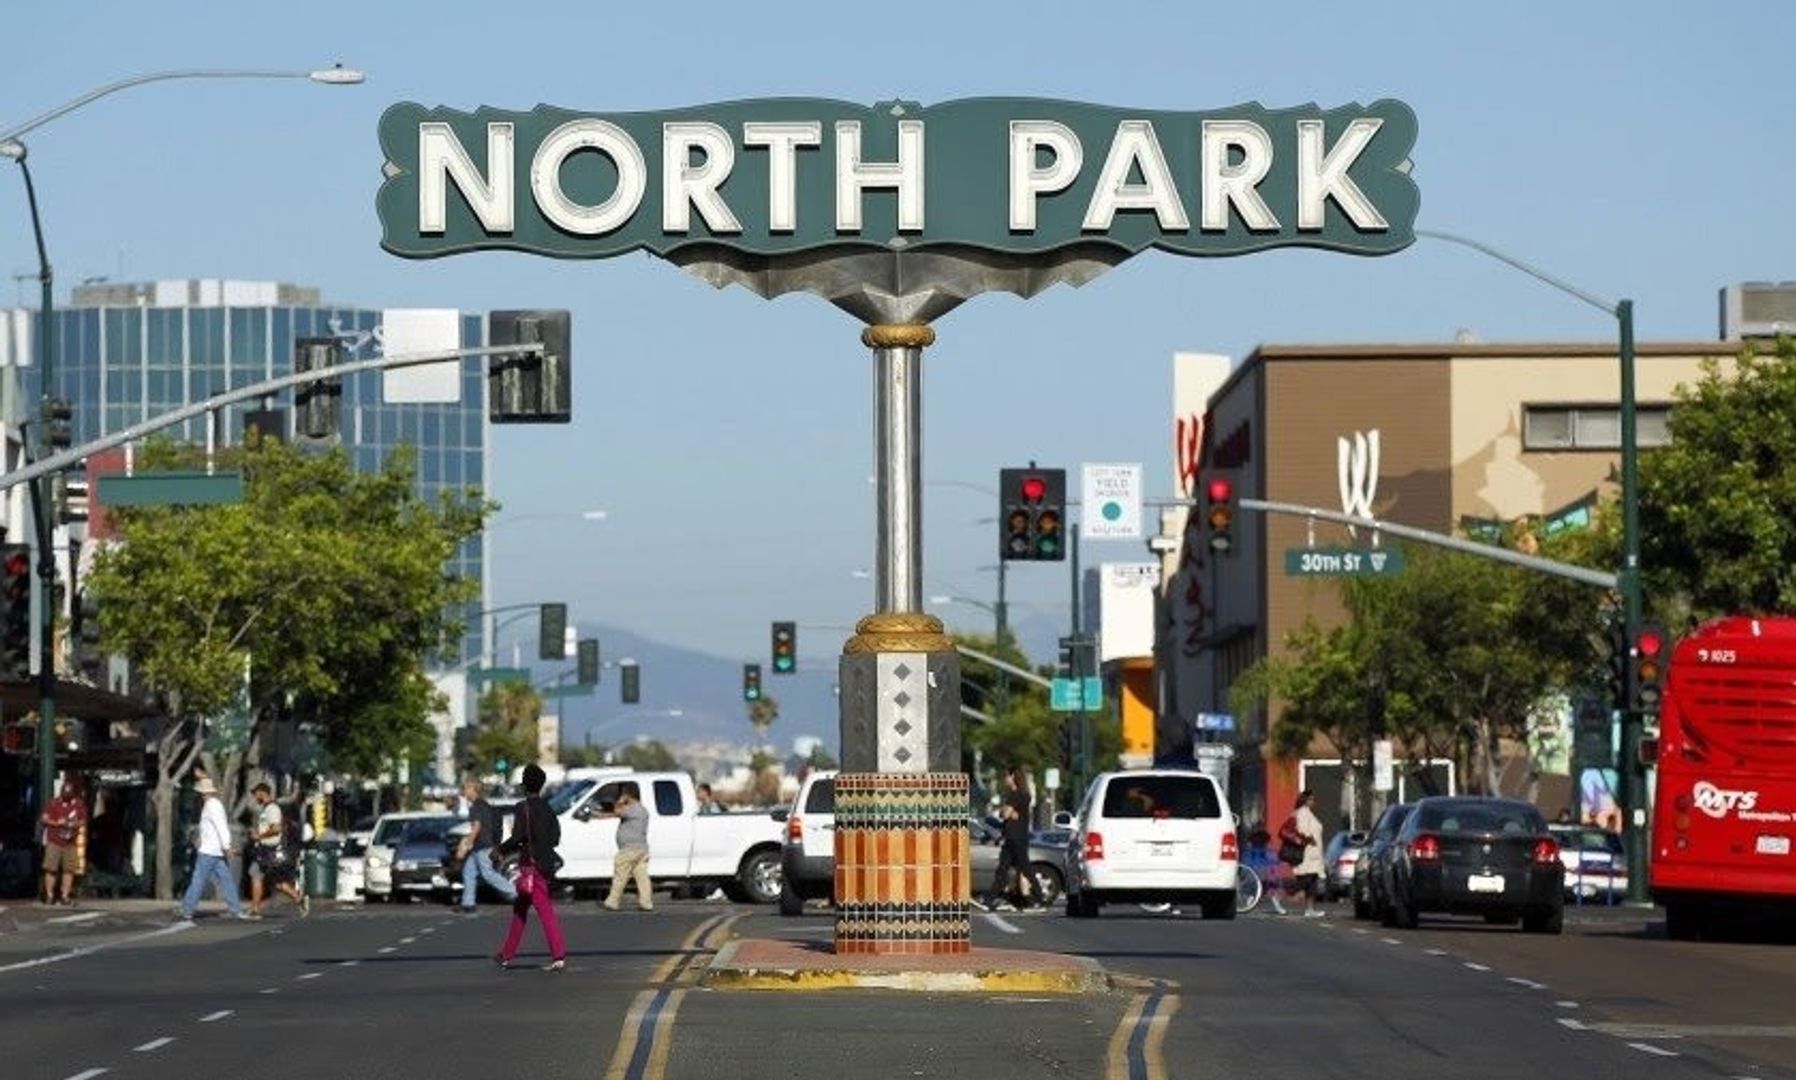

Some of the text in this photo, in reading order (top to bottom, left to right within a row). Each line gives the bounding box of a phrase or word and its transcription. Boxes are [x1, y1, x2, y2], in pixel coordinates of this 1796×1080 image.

[419, 117, 1390, 235] NORTH PARK
[1301, 552, 1362, 572] 30TH ST
[1710, 649, 1737, 663] 1025
[1694, 785, 1759, 813] MTS
